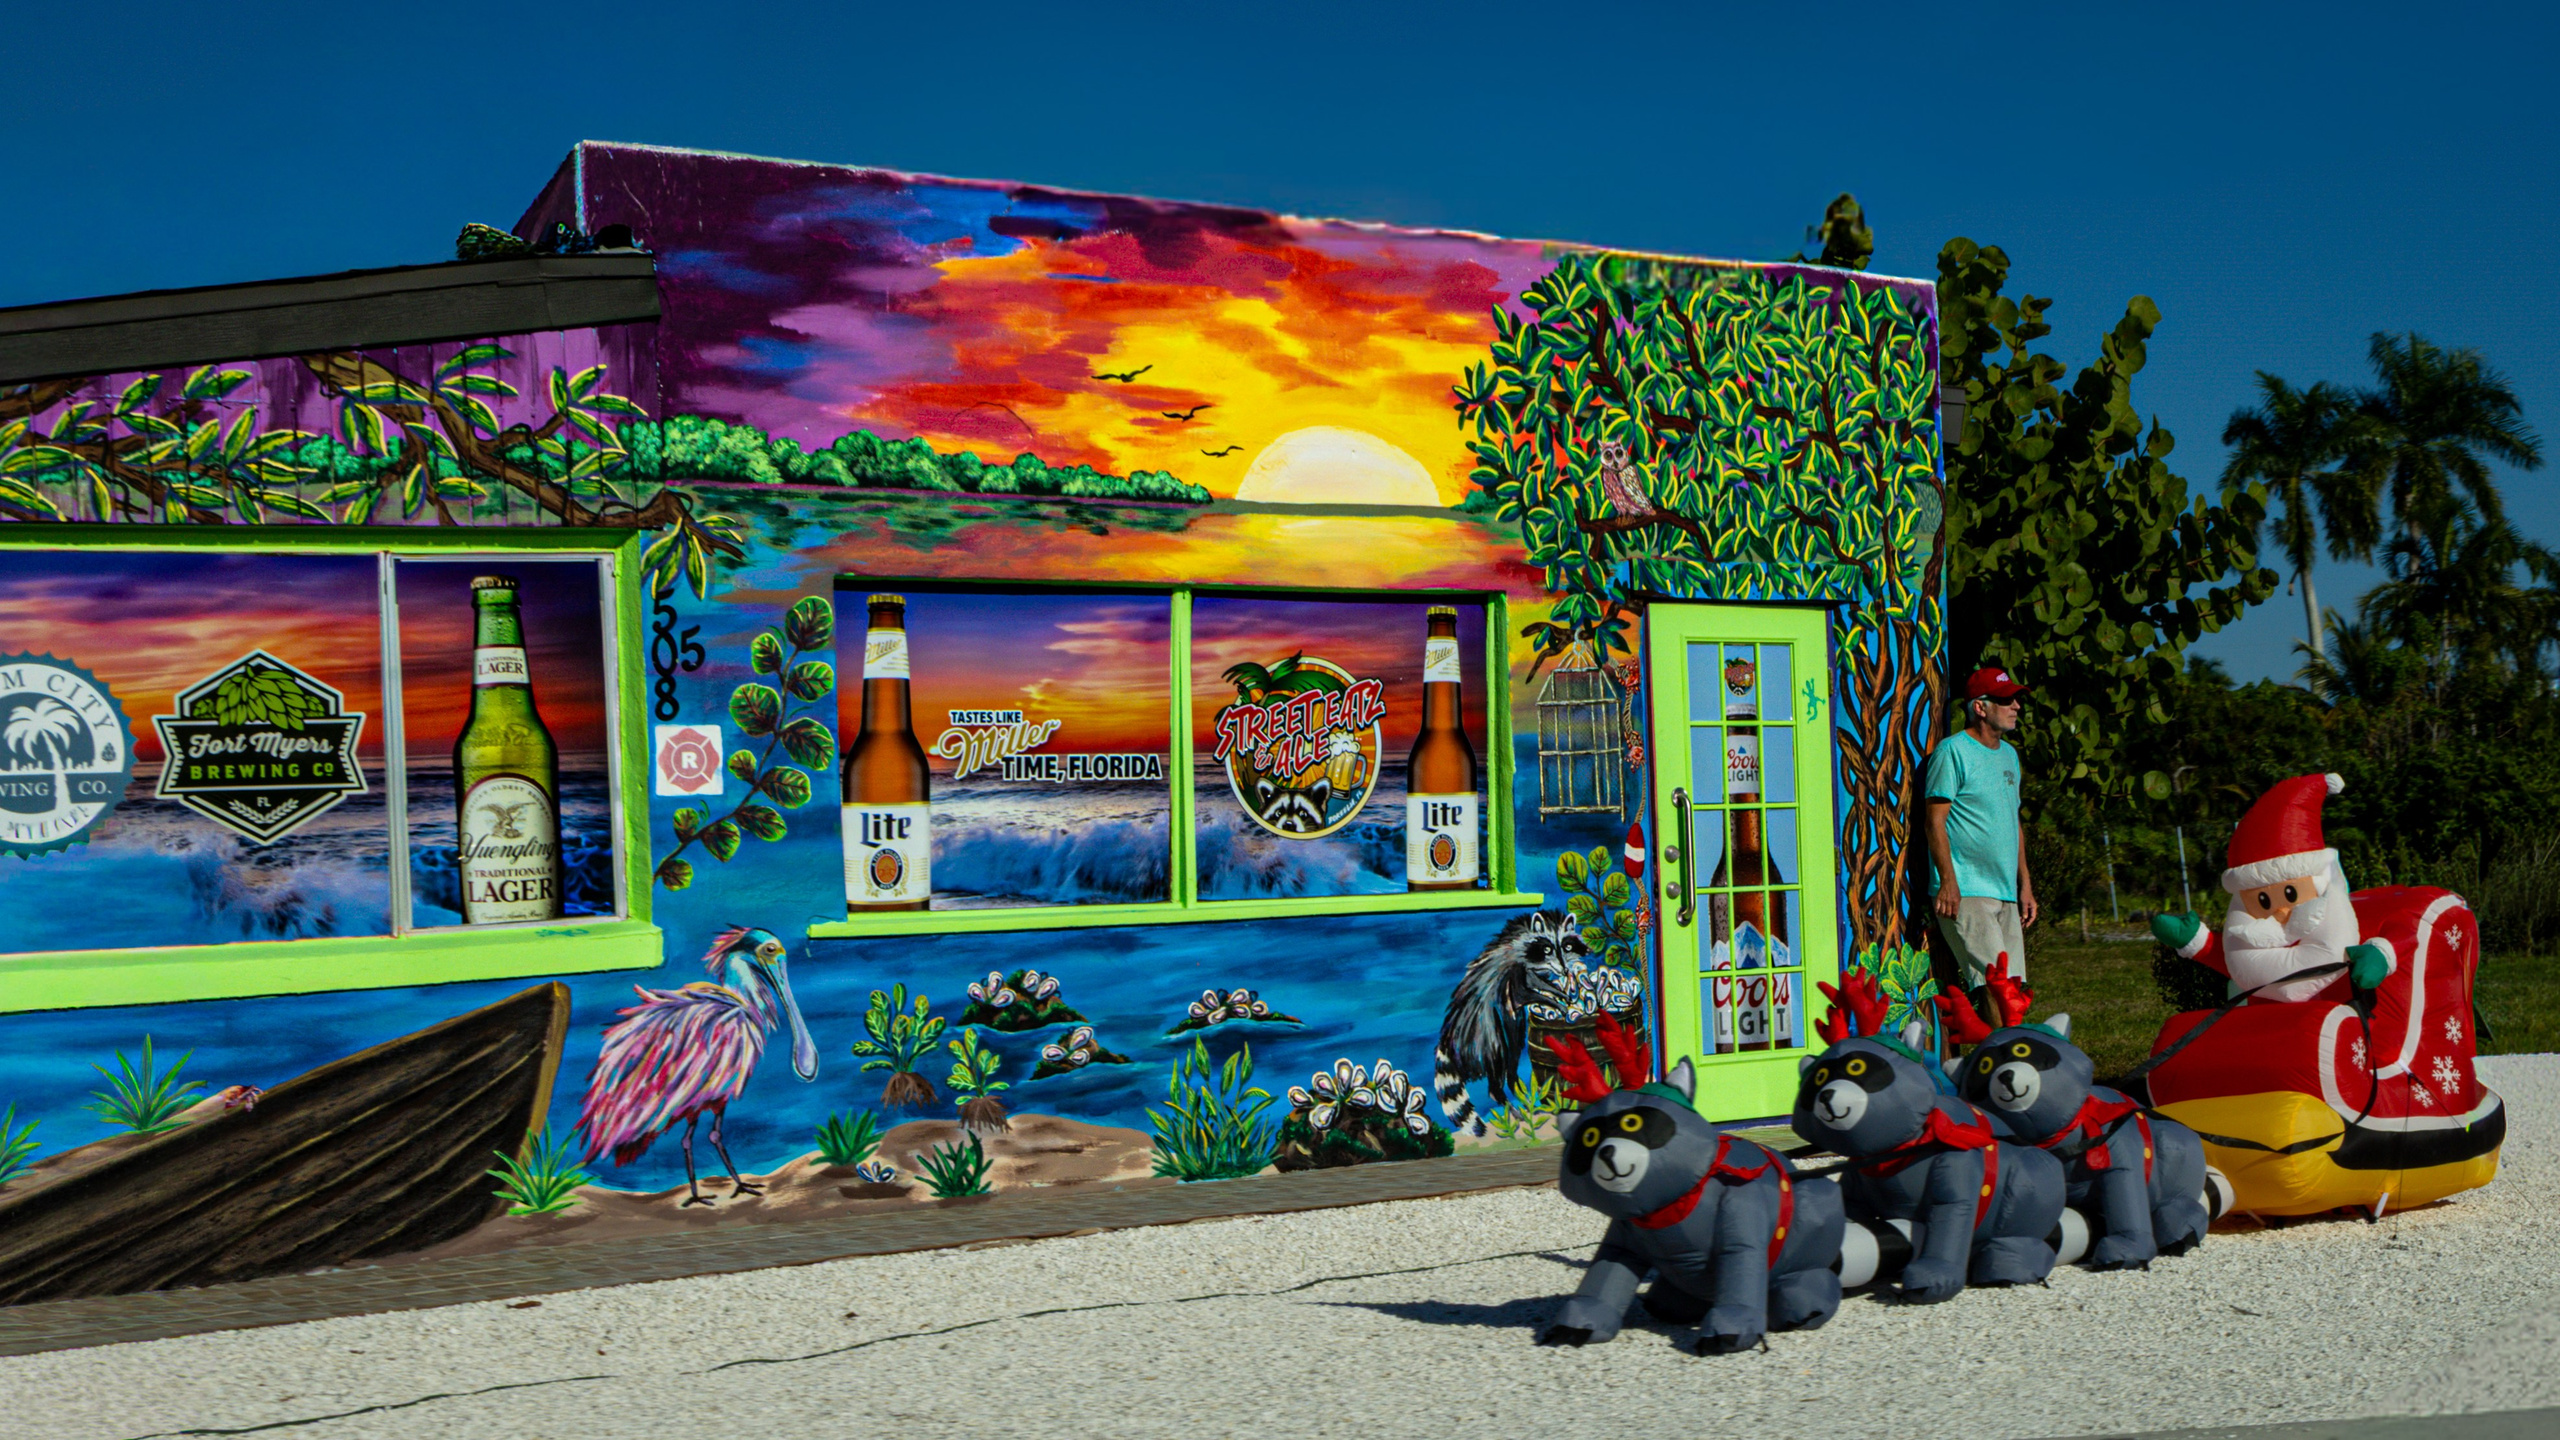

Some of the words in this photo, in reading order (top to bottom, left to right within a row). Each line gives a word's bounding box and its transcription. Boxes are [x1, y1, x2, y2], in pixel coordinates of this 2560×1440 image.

[478, 661, 524, 676] LAGER
[47, 673, 115, 730] CITY
[950, 711, 994, 724] TASTES
[996, 711, 1022, 724] LIKE
[1214, 689, 1323, 760] STREET
[1323, 678, 1386, 731] EATZ
[188, 733, 248, 759] Fort
[249, 731, 334, 760] Myers
[938, 720, 1060, 779] Miller
[1254, 744, 1274, 770] &
[1274, 727, 1331, 778] ALE
[189, 763, 300, 780] BREWING
[681, 752, 699, 770] R
[1001, 755, 1064, 781] TIME,
[1069, 755, 1161, 779] FLORIDA
[78, 780, 113, 795] CO.
[257, 797, 272, 807] FL
[860, 812, 911, 848] Lite
[1421, 801, 1462, 834] Lite
[460, 832, 555, 865] Yuengling
[473, 866, 548, 878] TRADITIONAL
[467, 877, 554, 903] LAGER
[1718, 1008, 1786, 1036] LGHT
